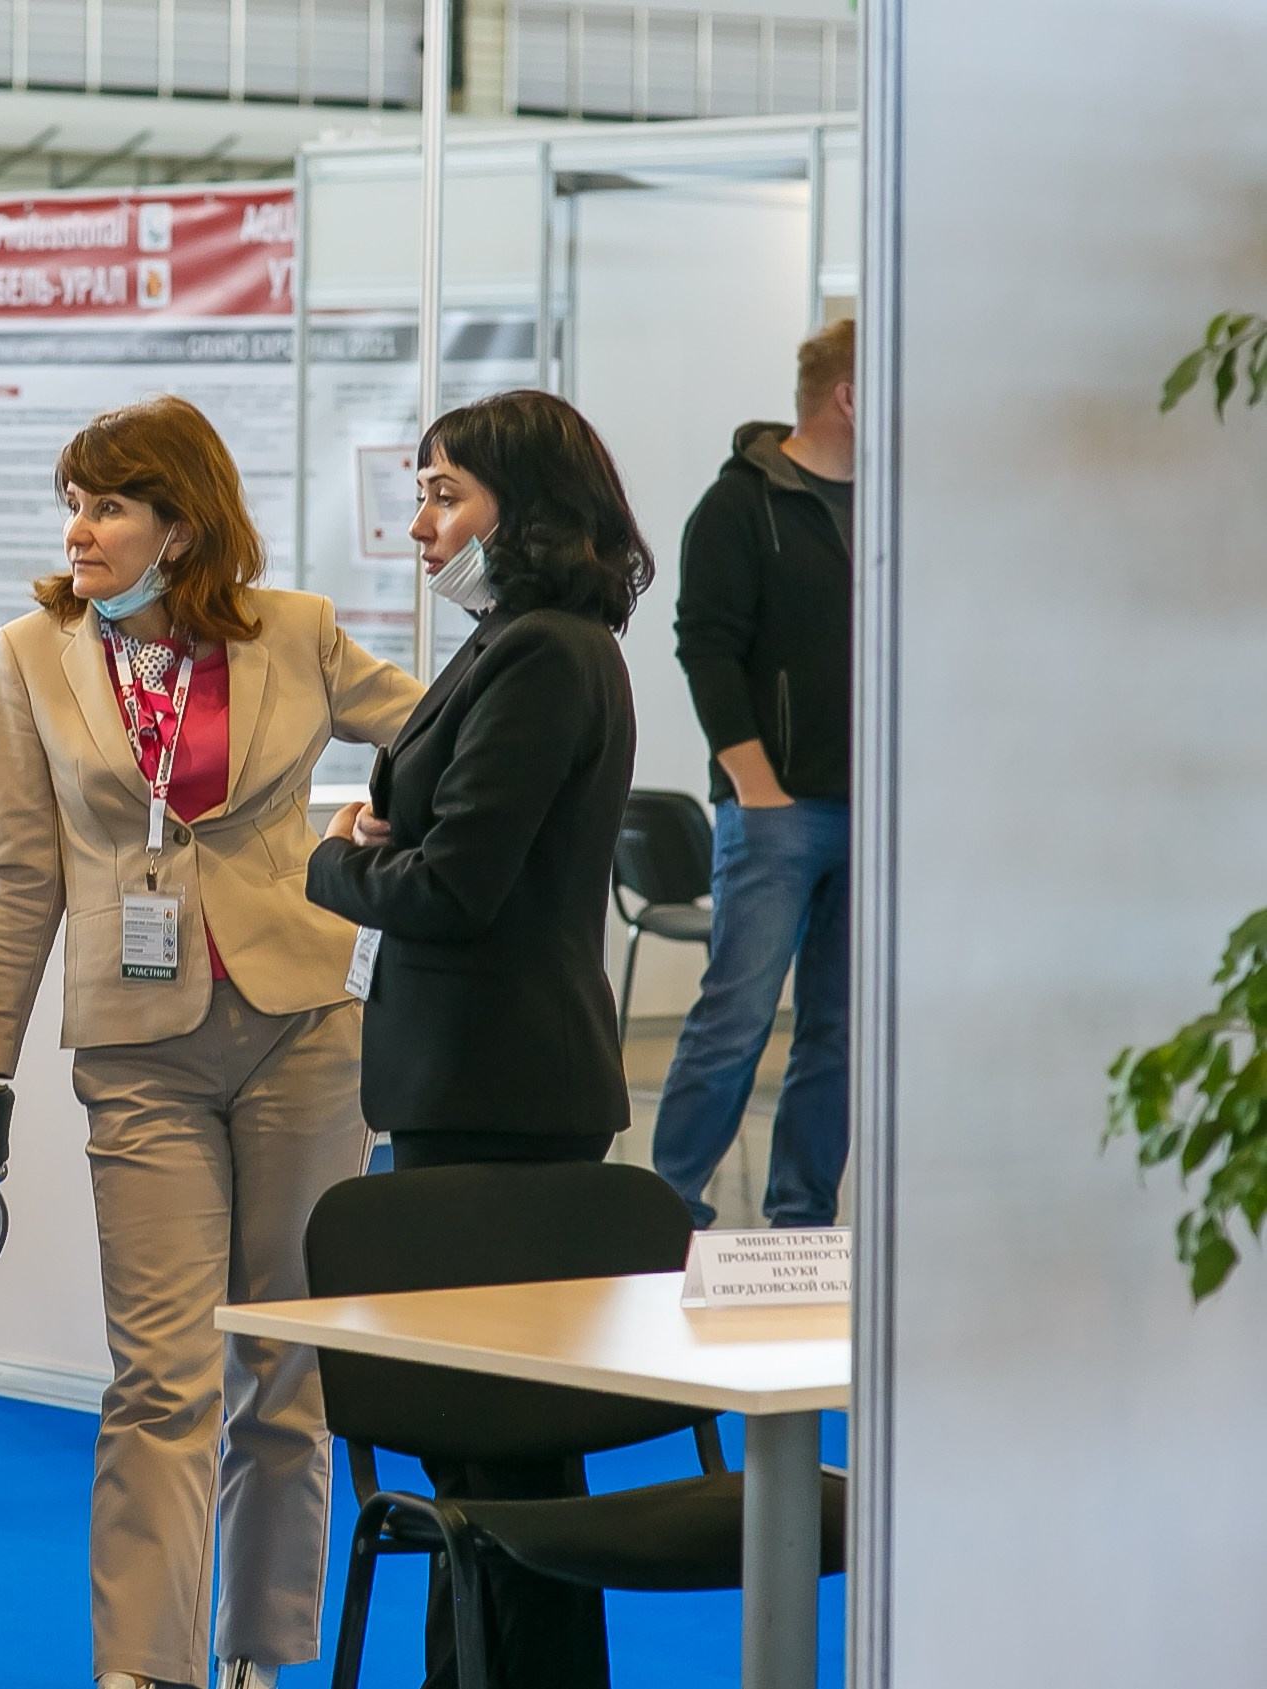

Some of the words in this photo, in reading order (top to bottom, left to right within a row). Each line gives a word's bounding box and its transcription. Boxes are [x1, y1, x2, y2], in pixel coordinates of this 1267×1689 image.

[127, 966, 172, 979] УЧАСТНИК
[735, 1234, 843, 1247] МИНИСТЕРСТВО
[772, 1266, 818, 1278] НАУКИ
[712, 1280, 817, 1297] СВЕРДЛОВСКОЙ
[821, 1281, 852, 1292] ОБЛ
